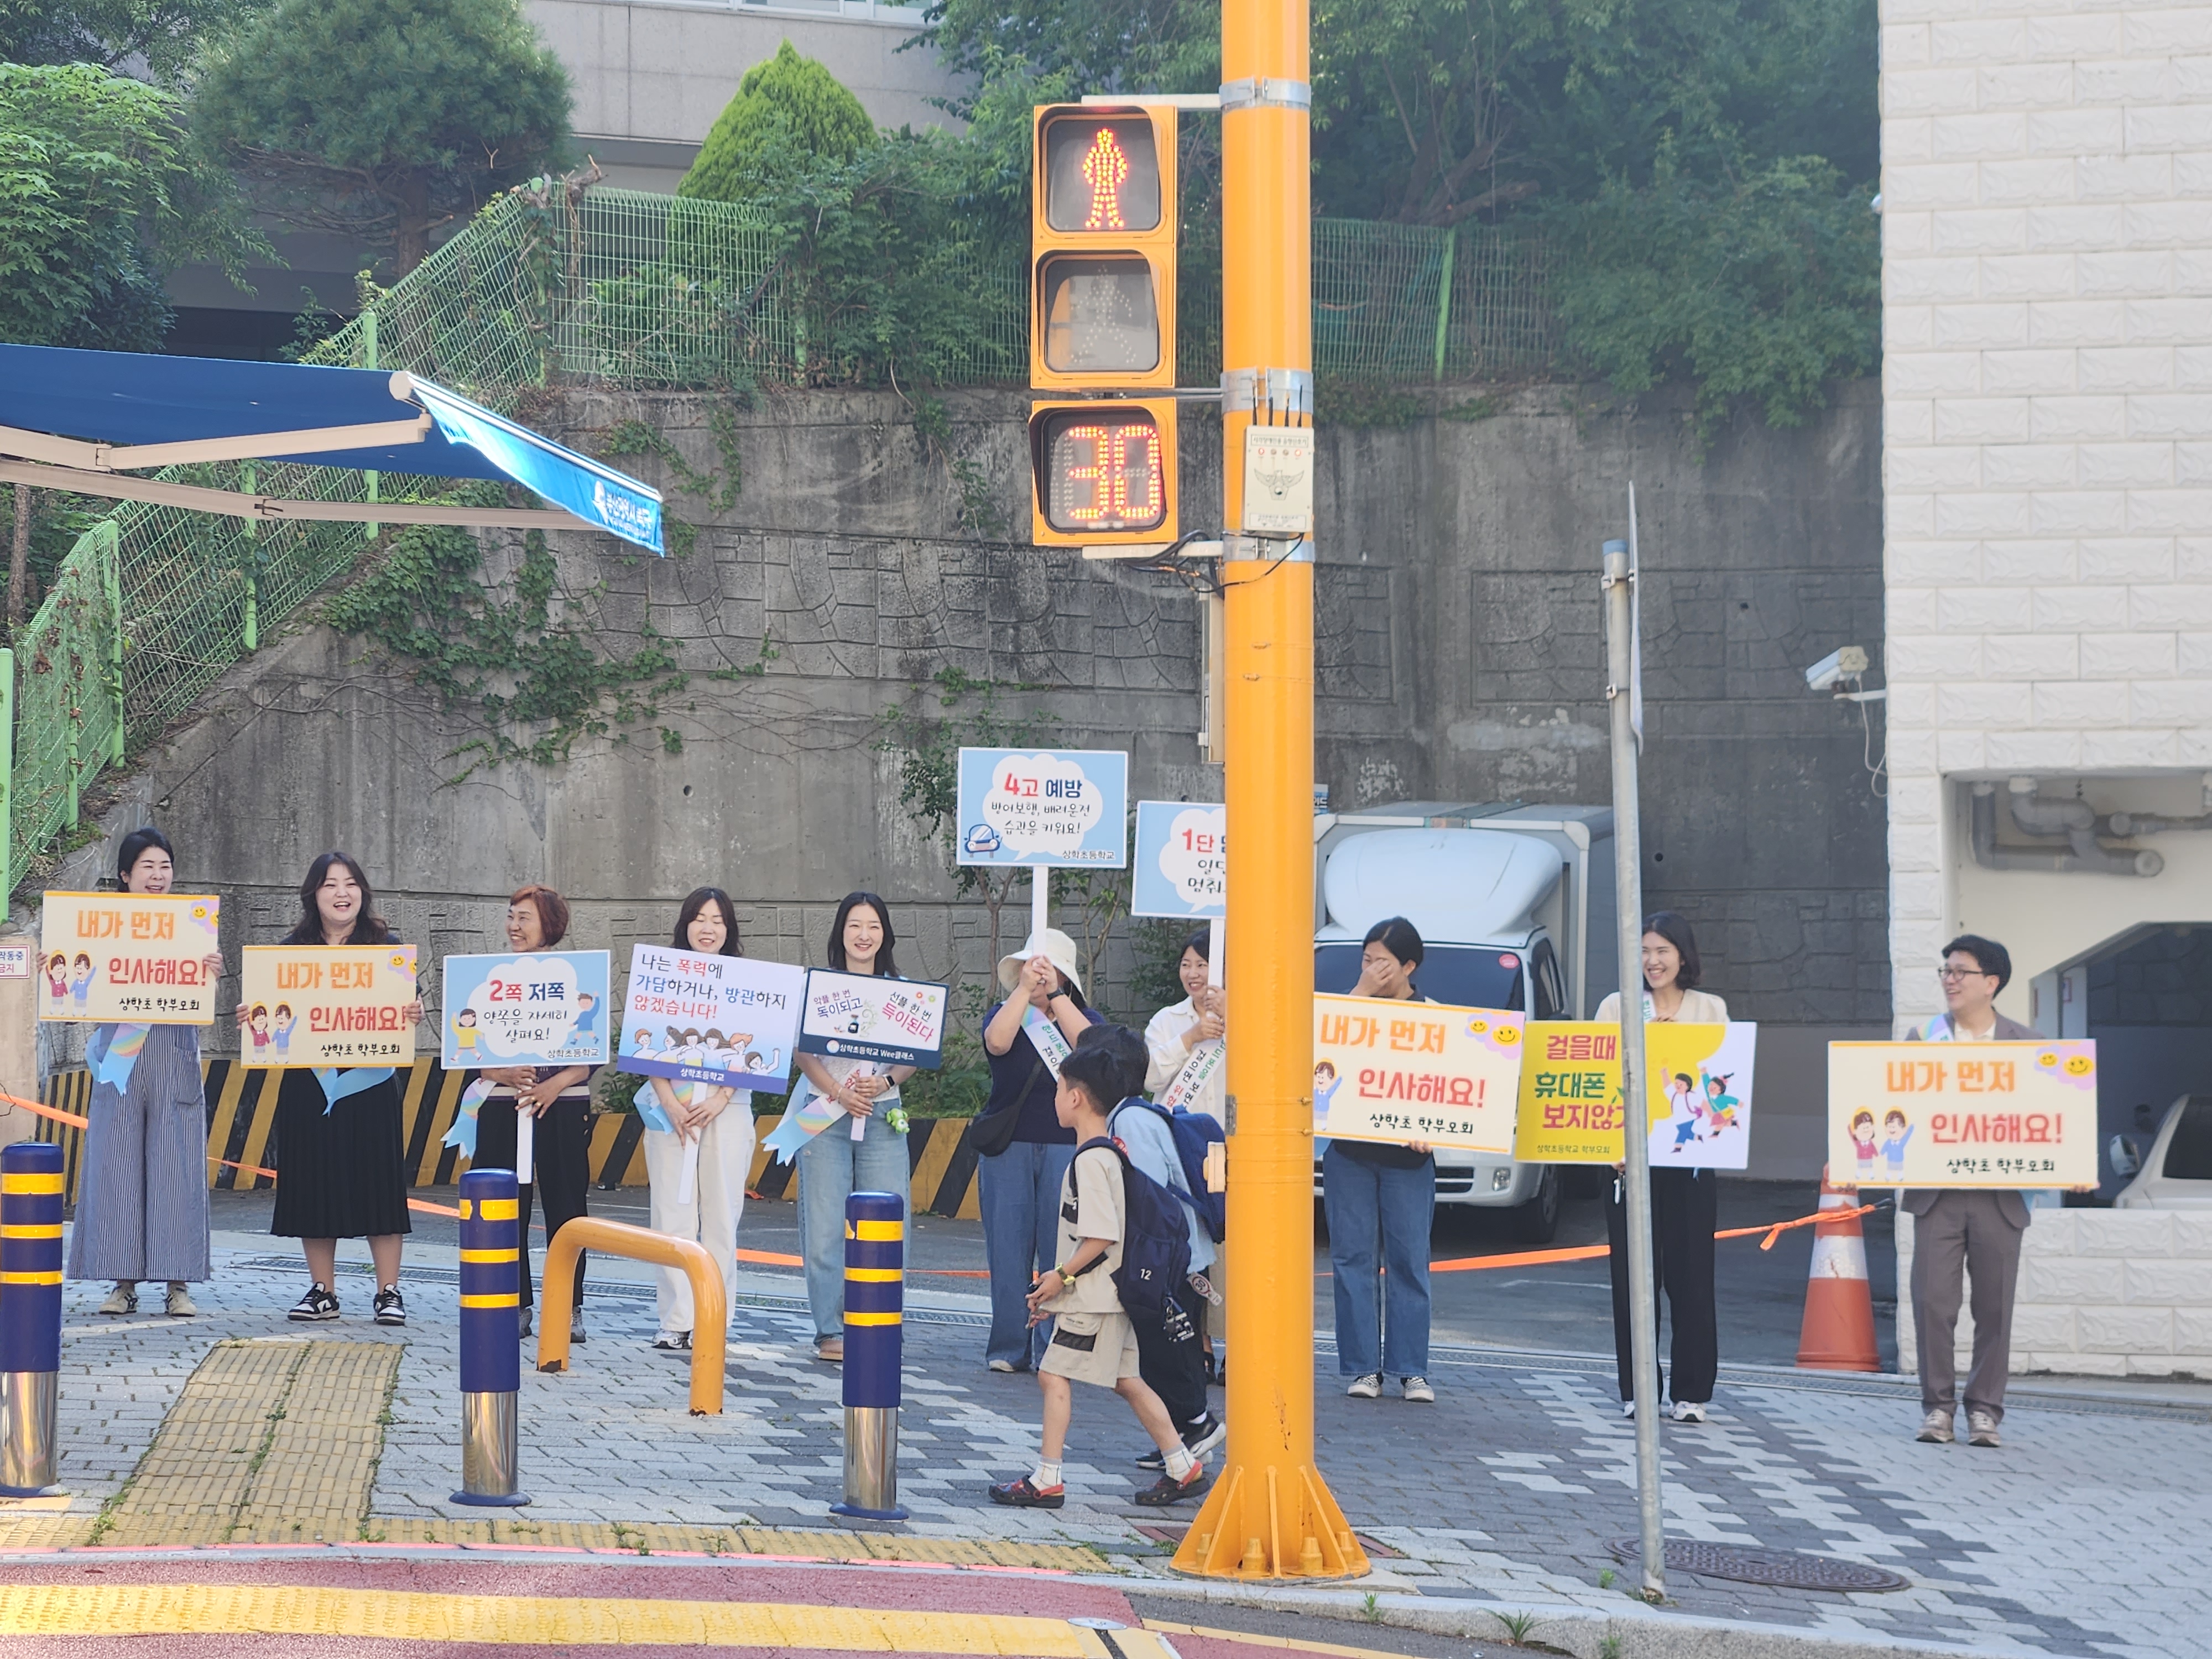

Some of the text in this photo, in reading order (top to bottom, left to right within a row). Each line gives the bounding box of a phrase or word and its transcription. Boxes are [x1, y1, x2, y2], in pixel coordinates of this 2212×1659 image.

[1068, 425, 1161, 519] 30
[1004, 773, 1082, 798] 4고 예방
[992, 801, 1090, 817] 방어보행, 배려운전
[1004, 820, 1081, 836] 습관을 키워요!
[1182, 828, 1214, 853] 1단
[1062, 851, 1115, 860] 상학초등학교
[1188, 877, 1226, 894] 멈춰
[77, 910, 175, 940] 내가 먼저
[108, 958, 207, 986] 인사해요!
[277, 962, 373, 989] 내가 먼저
[641, 953, 723, 979] 나는 폭력에
[489, 979, 565, 1002] 2쪽 저쪽
[637, 974, 786, 1010] 가담하거나, 방관하지
[814, 989, 851, 1005] 악플 한 번
[119, 997, 152, 1011] 상학초
[635, 995, 717, 1020] 않겠습니다!
[817, 998, 863, 1018] 독이되고
[890, 992, 932, 1022] 선플 한 번
[310, 1006, 406, 1032] 인사해요!
[484, 1009, 567, 1026] 양쪽을 자세히
[506, 1027, 550, 1043] 살펴요!
[1319, 1013, 1446, 1054] 내가 먼저
[321, 1044, 353, 1057] 상학초
[547, 1048, 599, 1058] 상학초등학교
[839, 1044, 915, 1061] 상학초등학교 Wee클래스
[1546, 1034, 1616, 1061] 걸을때
[680, 1068, 724, 1081] 상학초등학교
[1535, 1071, 1605, 1099] 휴대폰
[1886, 1061, 2015, 1093] 내가 먼저
[1358, 1068, 1486, 1108] 인사해요!
[1370, 1113, 1411, 1130] 상학초
[1931, 1113, 2063, 1144] 인사해요!
[1537, 1144, 1578, 1154] 상학초등학교
[1947, 1159, 1991, 1174] 상학초
[1140, 1269, 1152, 1281] 12
[1195, 1279, 1206, 1291] 30
